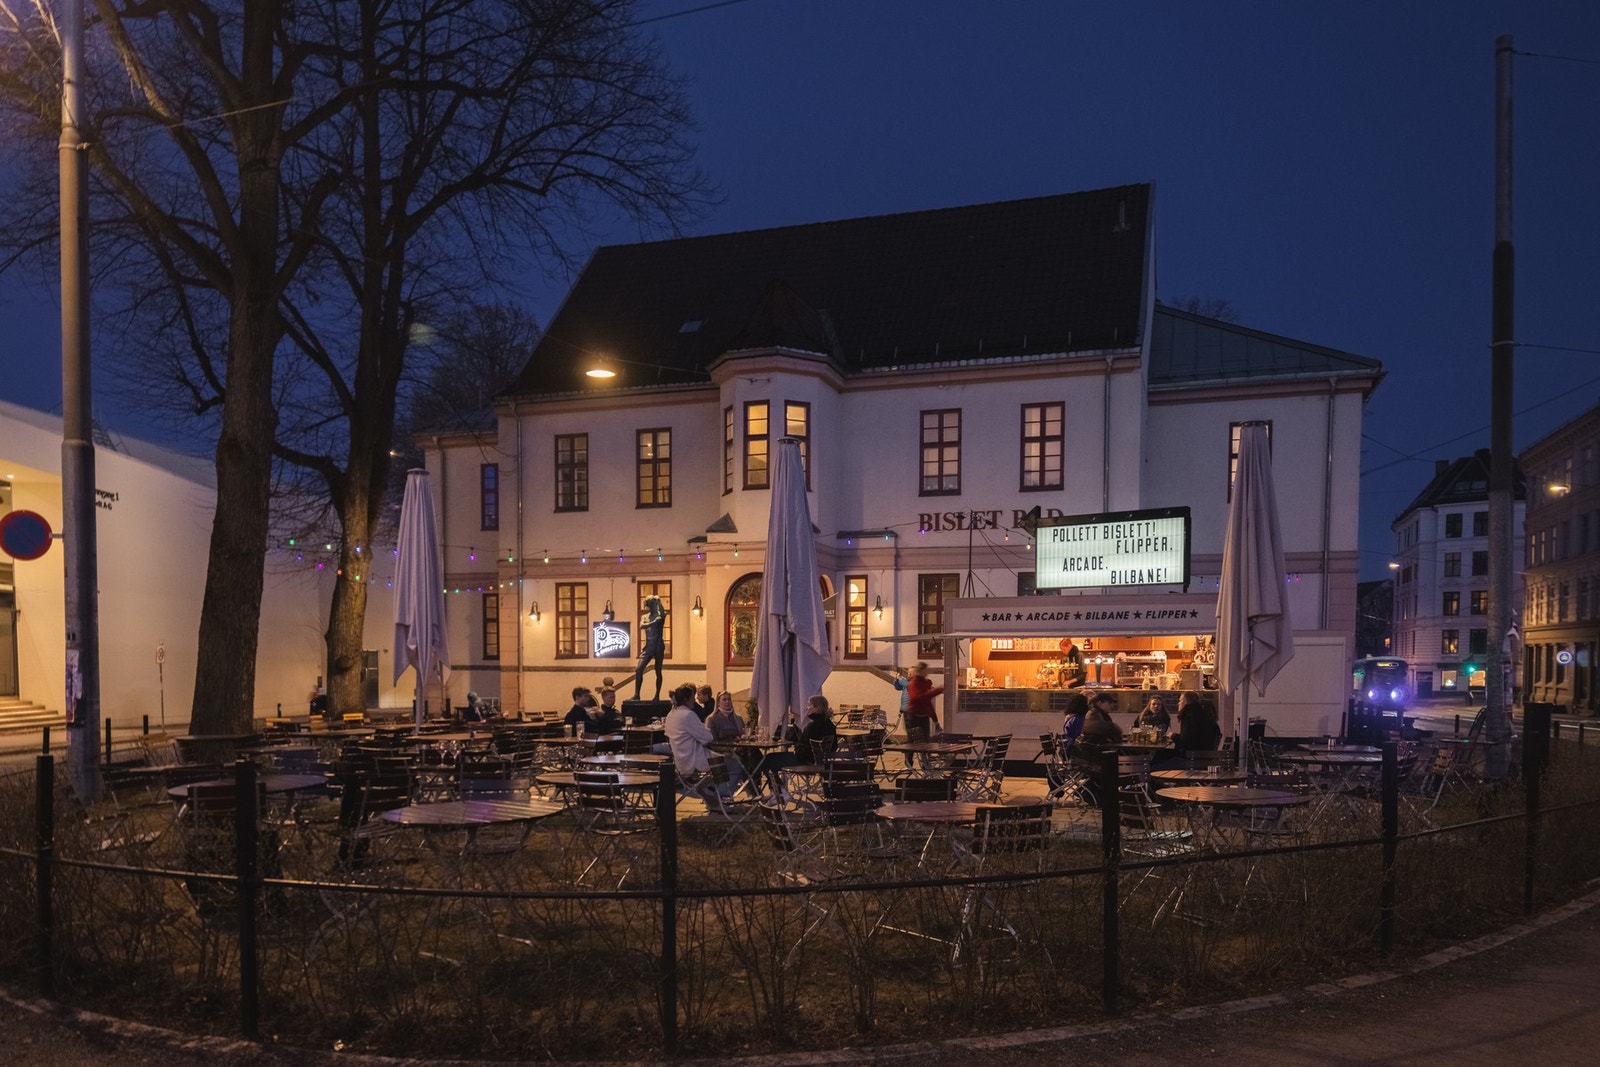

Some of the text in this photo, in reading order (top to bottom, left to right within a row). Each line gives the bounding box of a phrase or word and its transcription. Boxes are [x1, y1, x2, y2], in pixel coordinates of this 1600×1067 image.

[918, 509, 1004, 533] BISLET
[1052, 521, 1156, 543] POLLETT BISLETT!
[1116, 536, 1173, 554] FLIPPER.
[1062, 556, 1108, 572] ARCADE.
[1110, 567, 1167, 584] BILBANE!
[991, 609, 1188, 622] BAR ARCADE BILBANE FLIPPER
